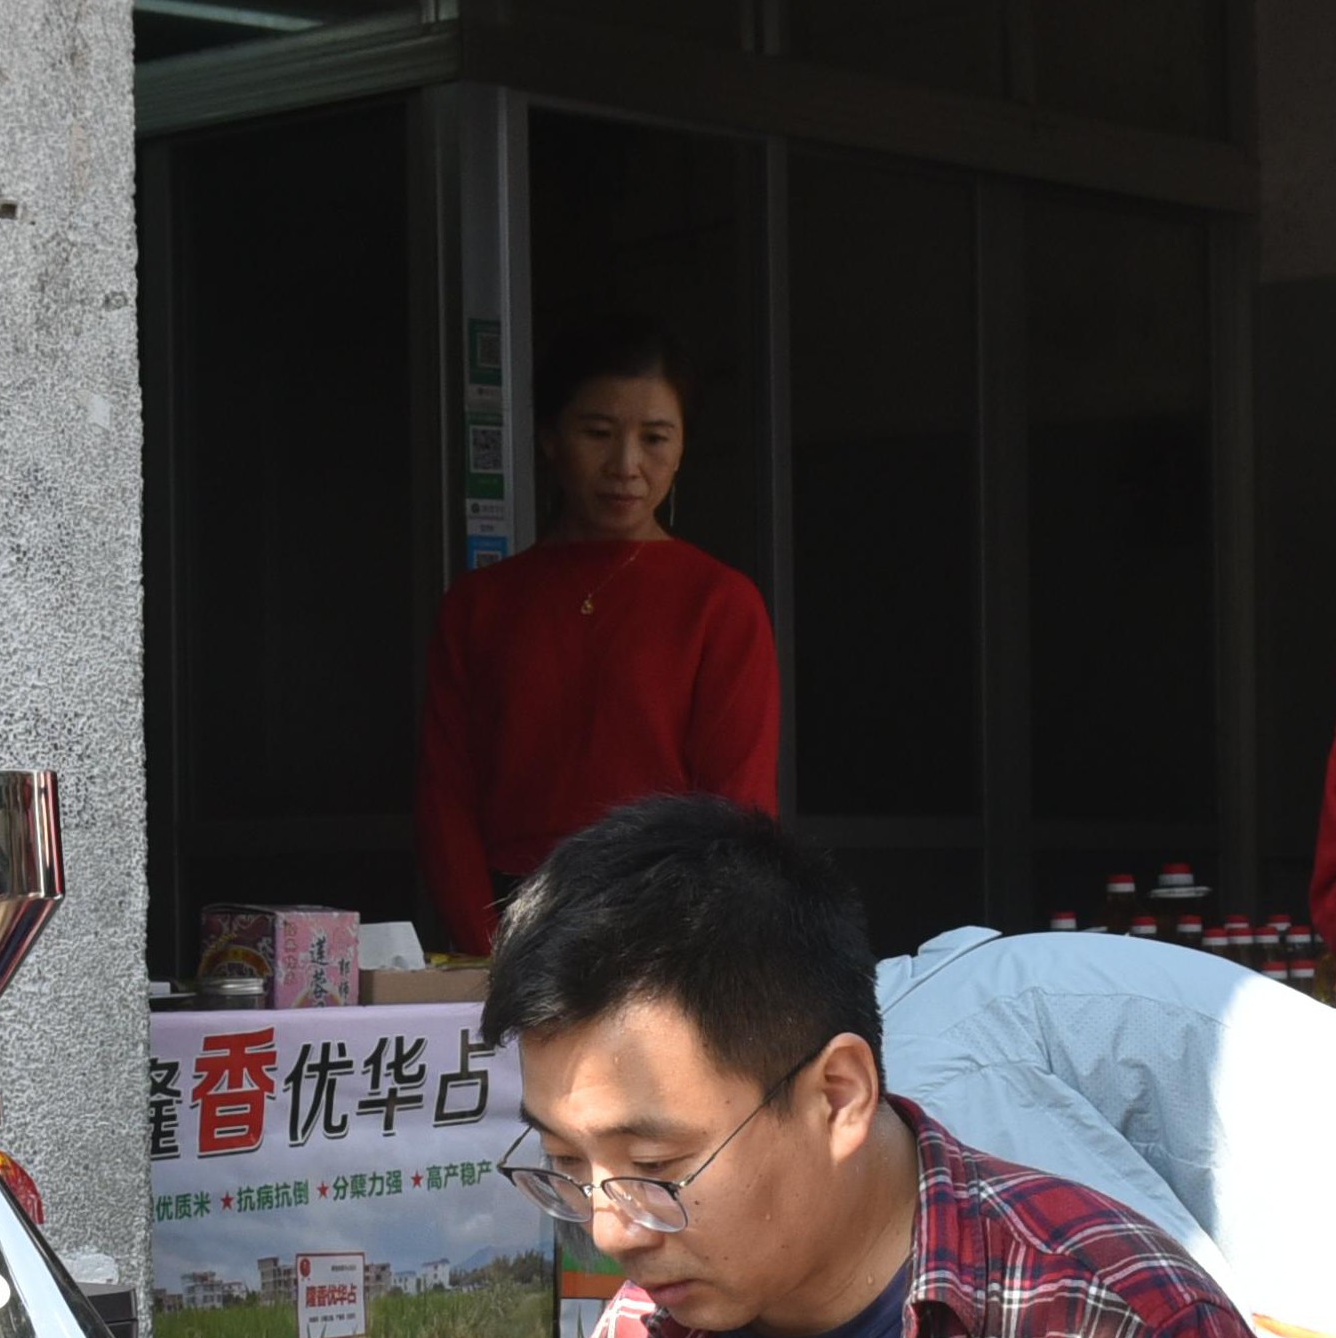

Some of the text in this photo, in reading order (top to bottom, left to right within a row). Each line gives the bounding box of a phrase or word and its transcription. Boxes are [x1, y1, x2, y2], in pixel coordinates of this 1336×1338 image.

[151, 1192, 211, 1223] 优质米
[236, 1178, 310, 1214] 抗病抗倒
[425, 1159, 493, 1191] 高产稳产
